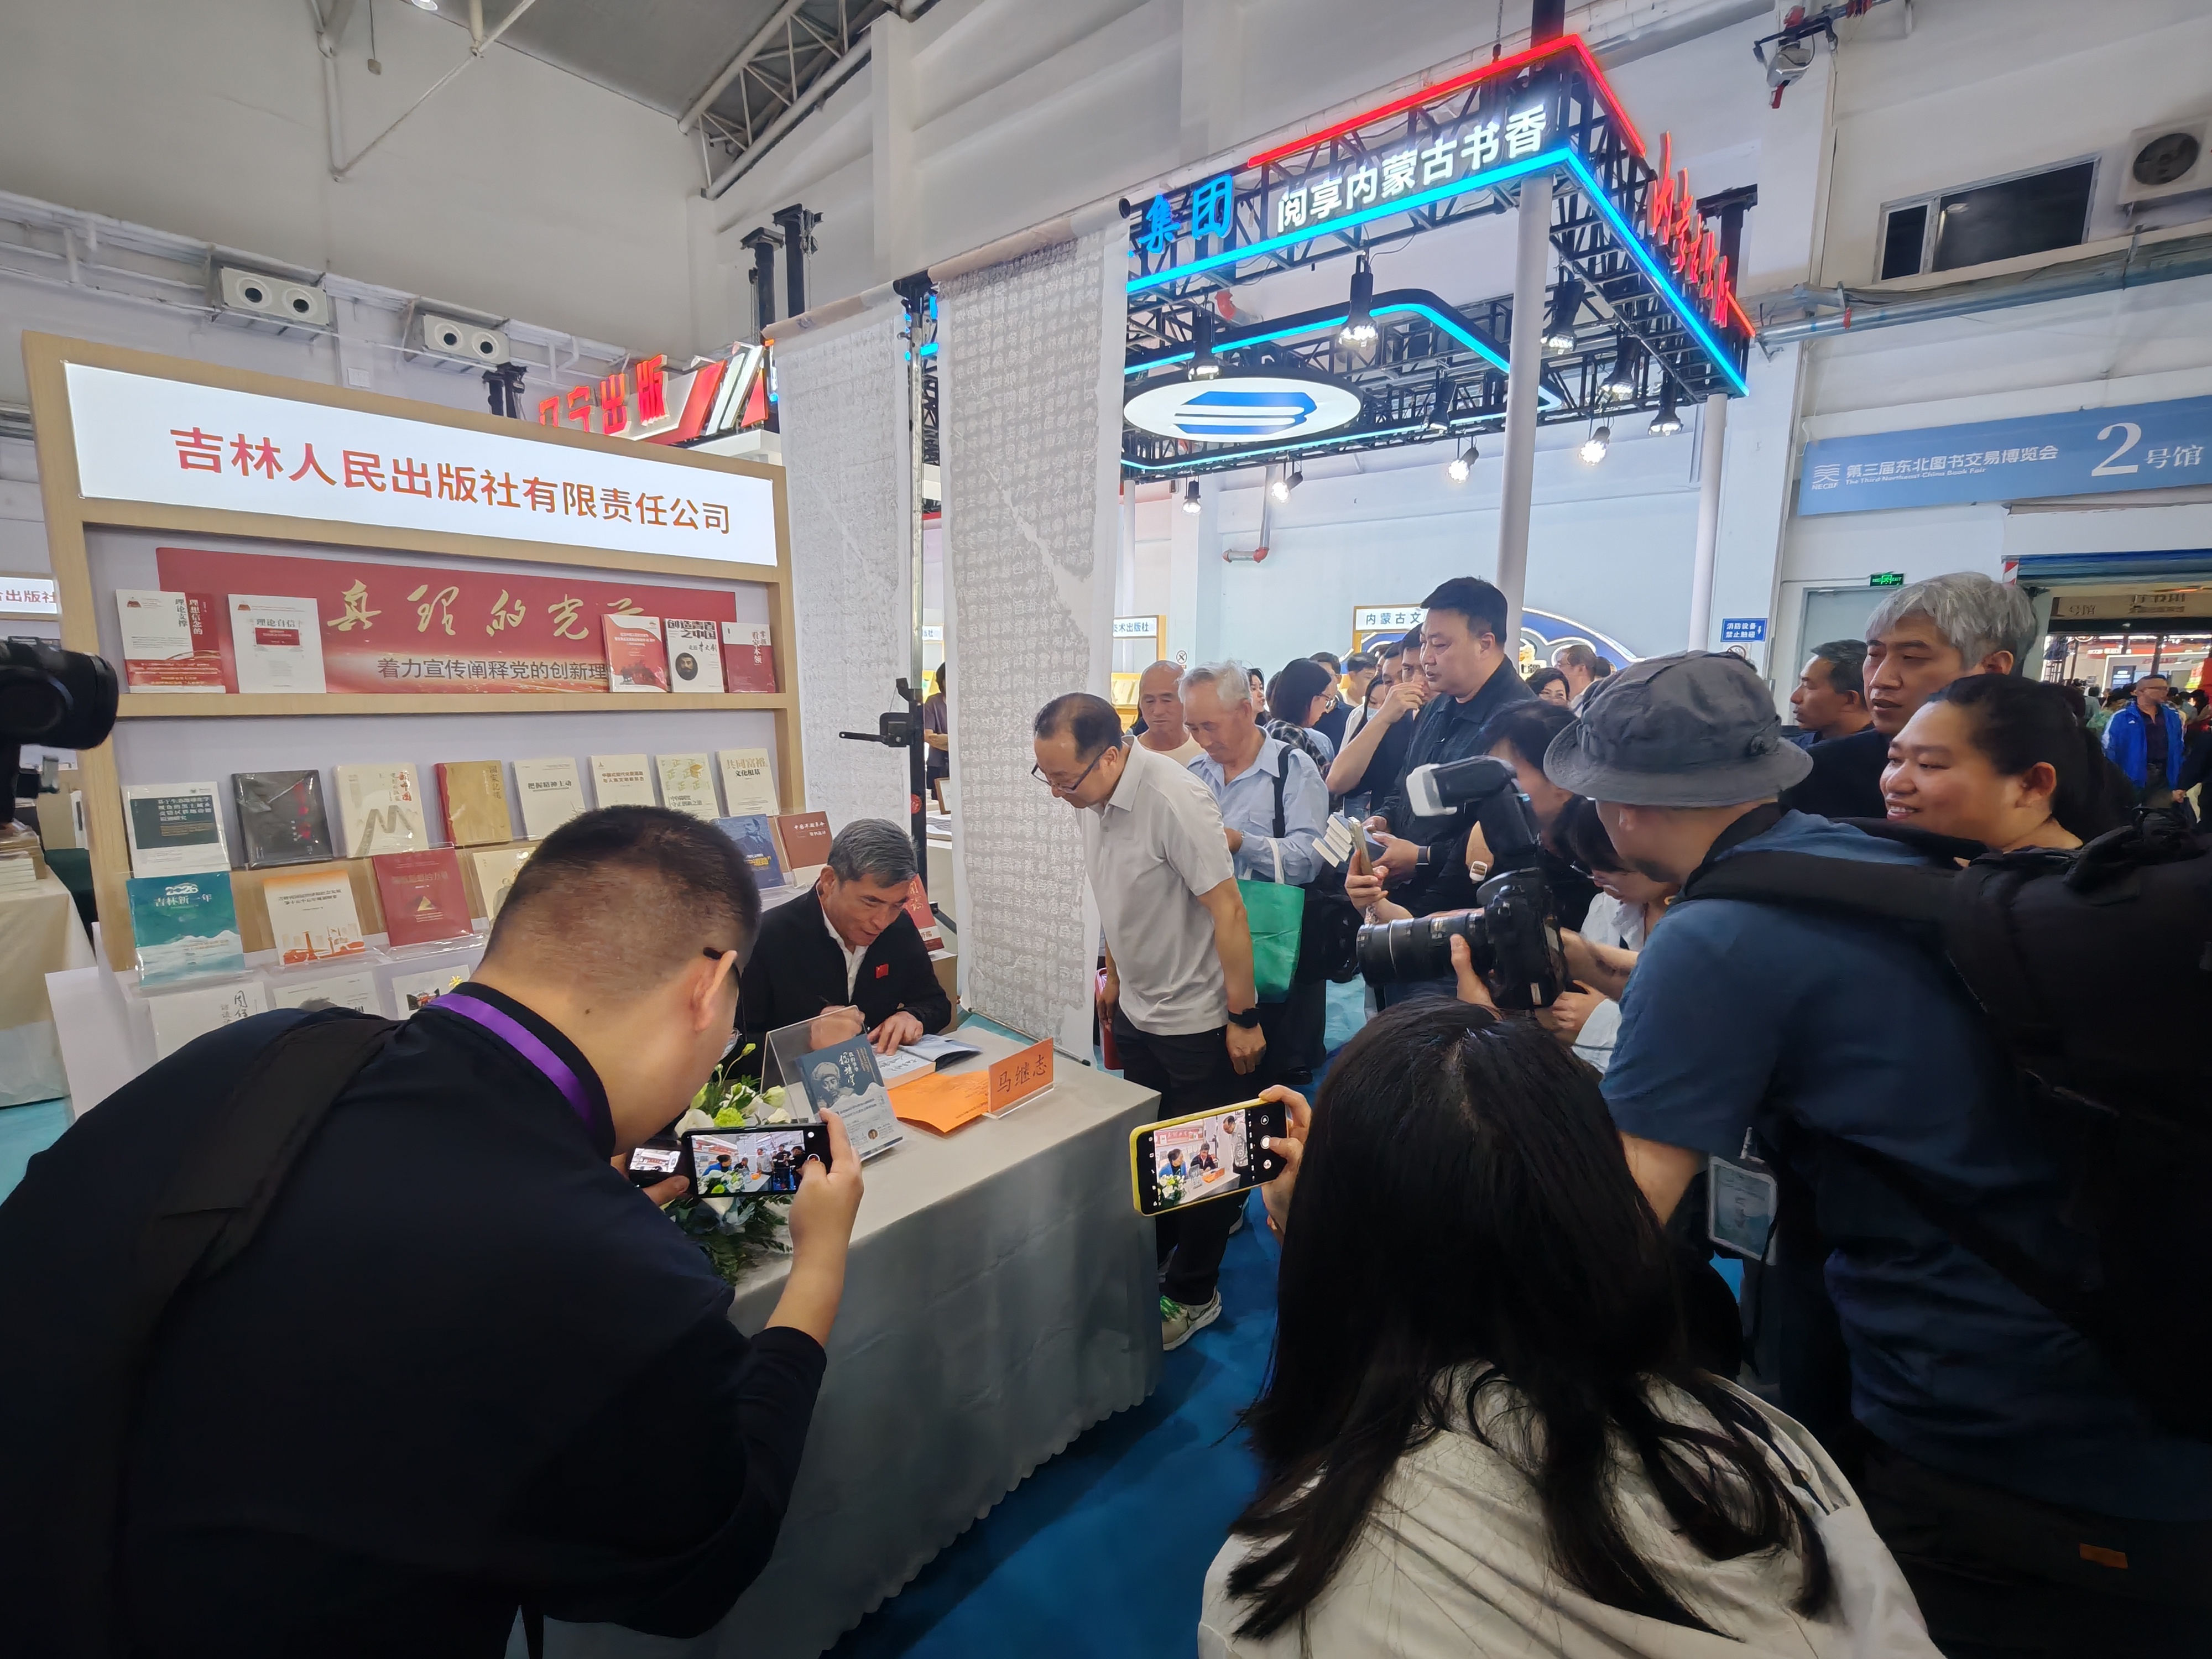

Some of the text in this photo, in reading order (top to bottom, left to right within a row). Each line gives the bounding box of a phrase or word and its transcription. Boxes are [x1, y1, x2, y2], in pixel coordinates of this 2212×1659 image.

[1278, 104, 1546, 232] 阅享内蒙古书香
[1138, 174, 1233, 253] 集团
[170, 426, 730, 534] 吉林人民出版社有限责任公司
[1846, 445, 2058, 478] 第三届东北图书交易博览会
[257, 618, 295, 628] 理论自信
[378, 658, 608, 681] 着力宣传阐释党的创新理
[997, 1055, 1047, 1093] 马继志
